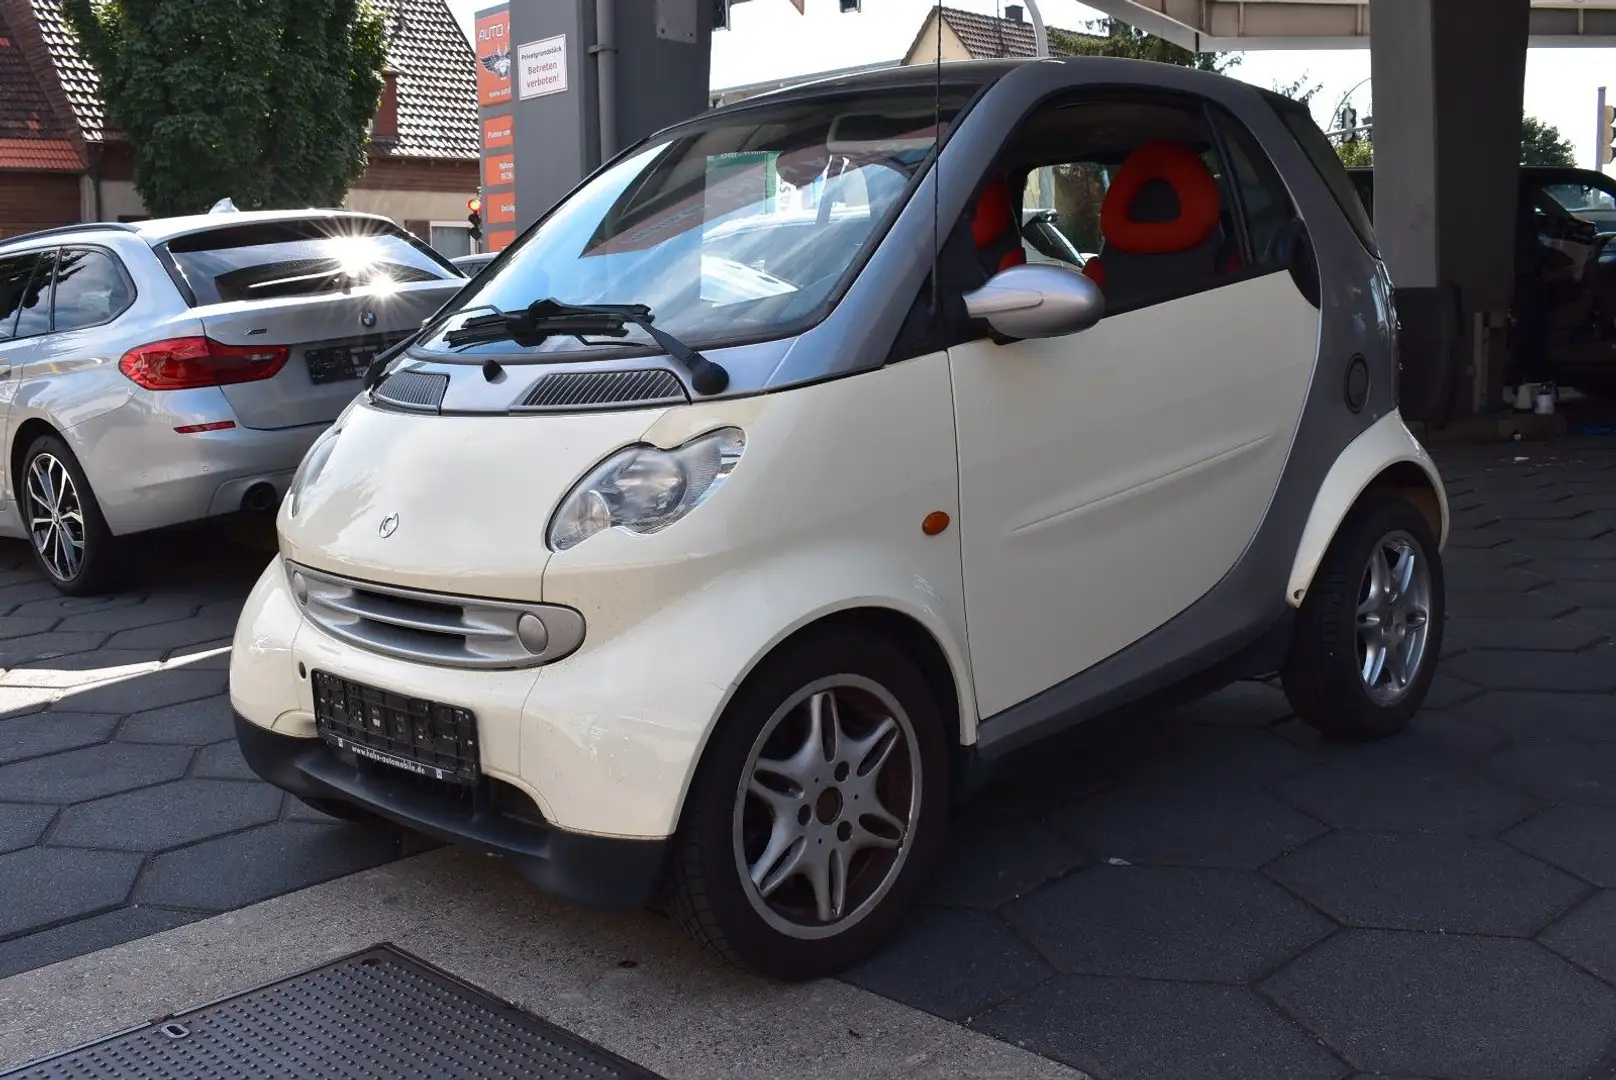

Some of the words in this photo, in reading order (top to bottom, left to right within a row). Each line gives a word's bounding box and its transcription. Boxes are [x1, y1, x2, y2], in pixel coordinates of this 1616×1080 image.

[479, 24, 503, 41] AUTO
[521, 46, 562, 60] Privatgrundstück
[528, 62, 557, 74] Betreten
[526, 74, 559, 88] verboten!
